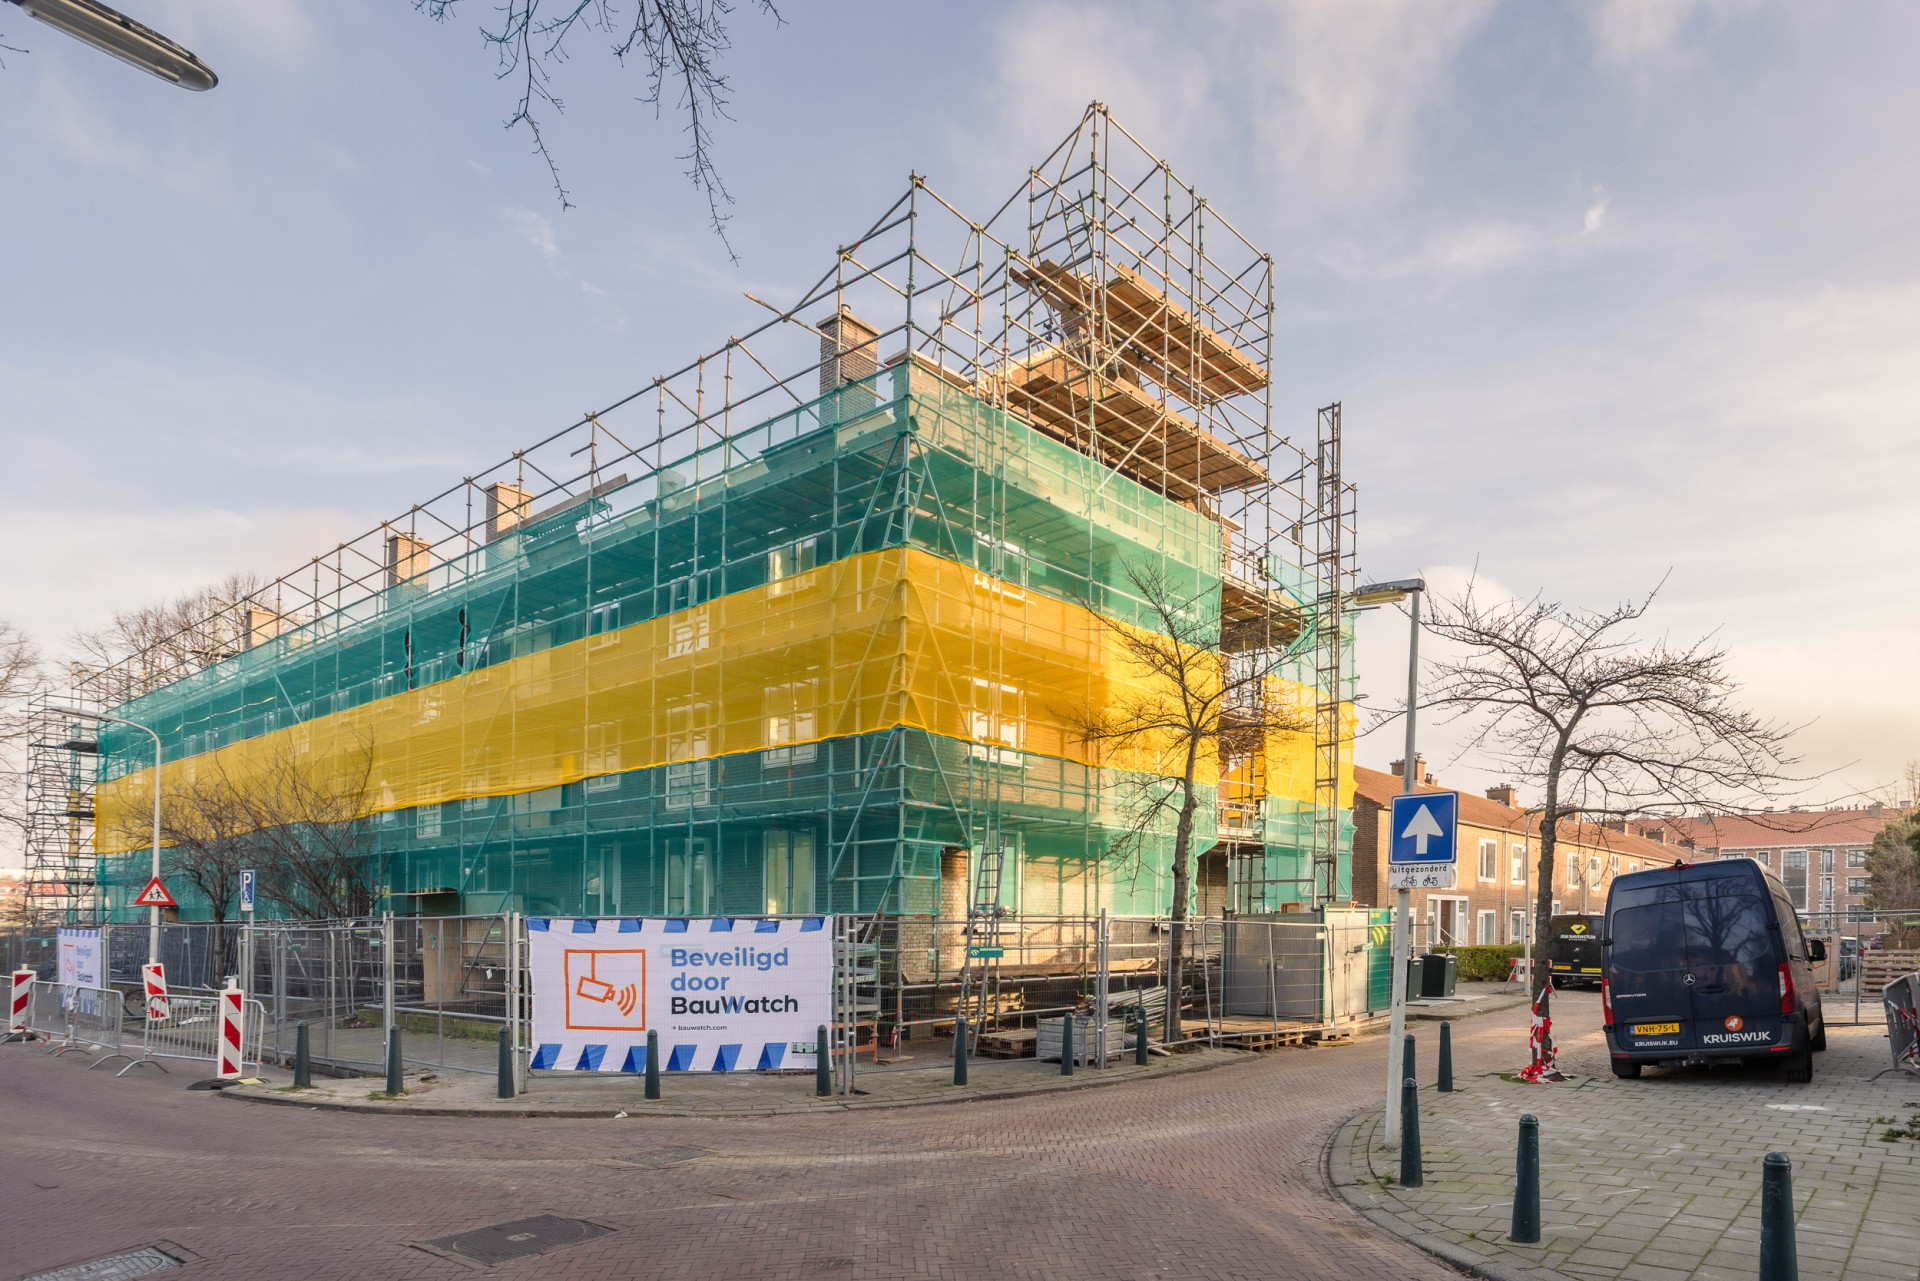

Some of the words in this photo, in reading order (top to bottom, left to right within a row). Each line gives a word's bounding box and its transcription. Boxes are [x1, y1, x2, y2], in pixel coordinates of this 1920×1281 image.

[1392, 865, 1447, 874] uitgezonderd
[243, 872, 252, 890] P
[671, 946, 788, 971] Beveiligd
[670, 972, 730, 991] door
[671, 995, 798, 1014] BauWatch
[1636, 1024, 1677, 1033] VNH-75-L
[1703, 1031, 1771, 1044] KRUISWIJK
